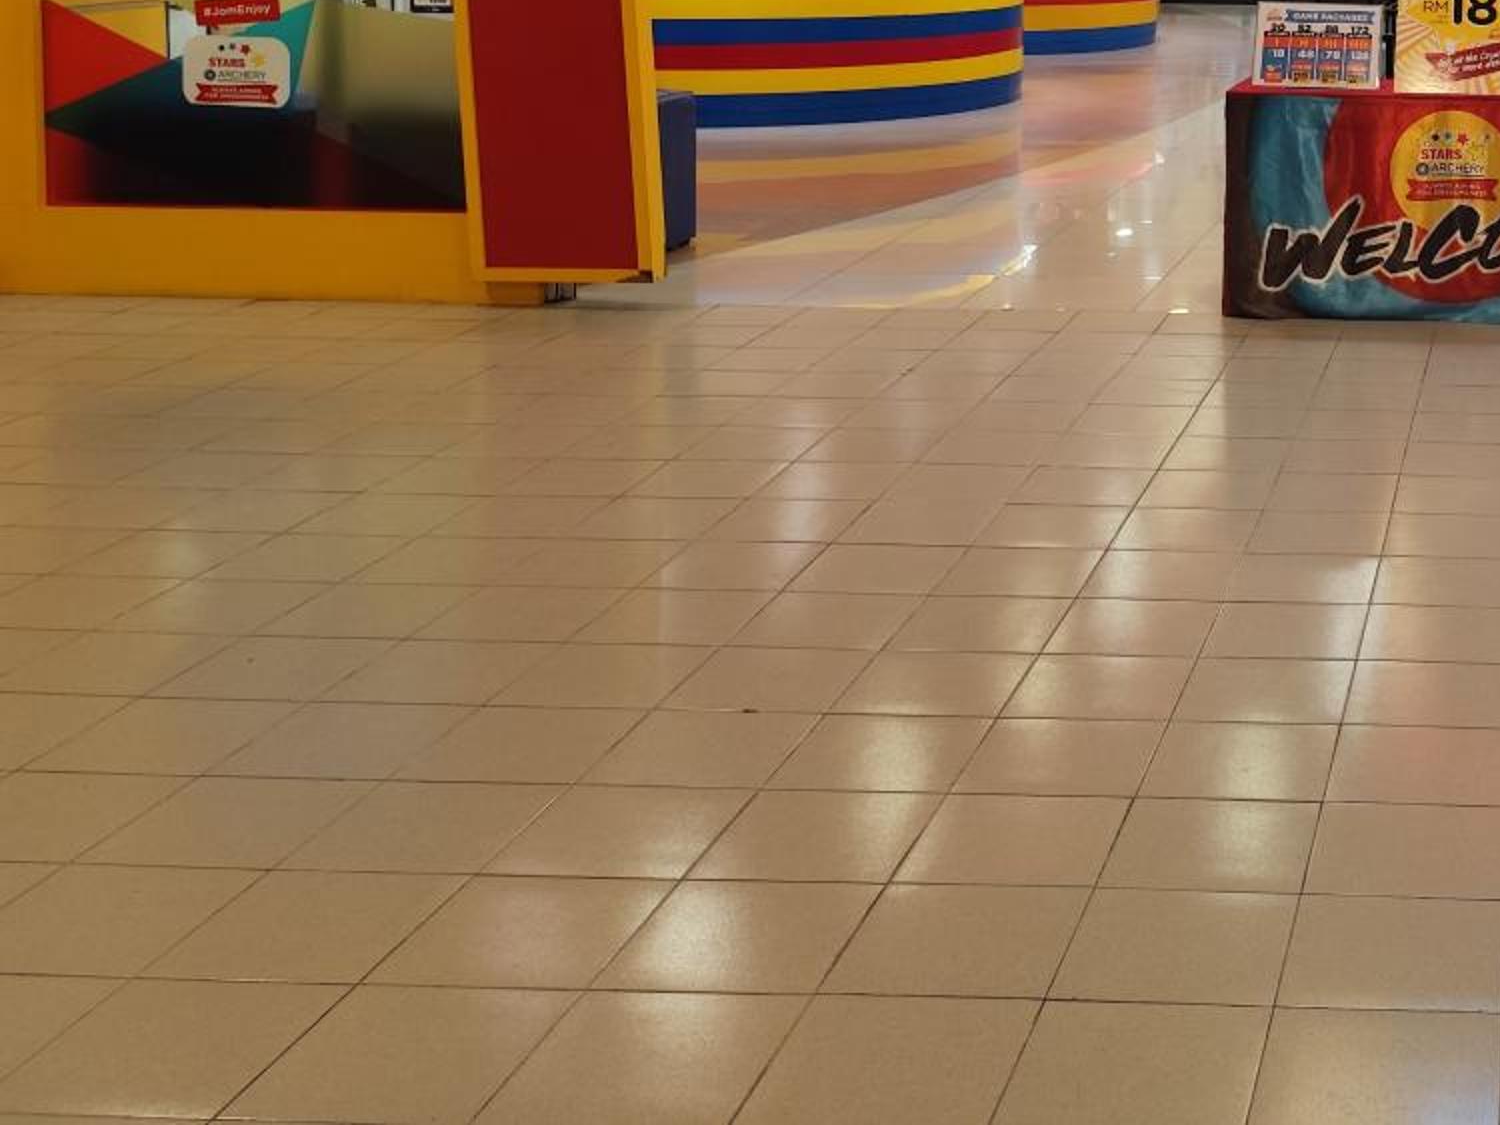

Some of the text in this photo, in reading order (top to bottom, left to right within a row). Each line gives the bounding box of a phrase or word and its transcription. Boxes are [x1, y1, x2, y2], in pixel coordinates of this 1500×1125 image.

[1423, 0, 1449, 13] RM
[207, 57, 246, 68] STARS
[1420, 148, 1463, 160] STARS
[1431, 162, 1485, 174] ARCHERY
